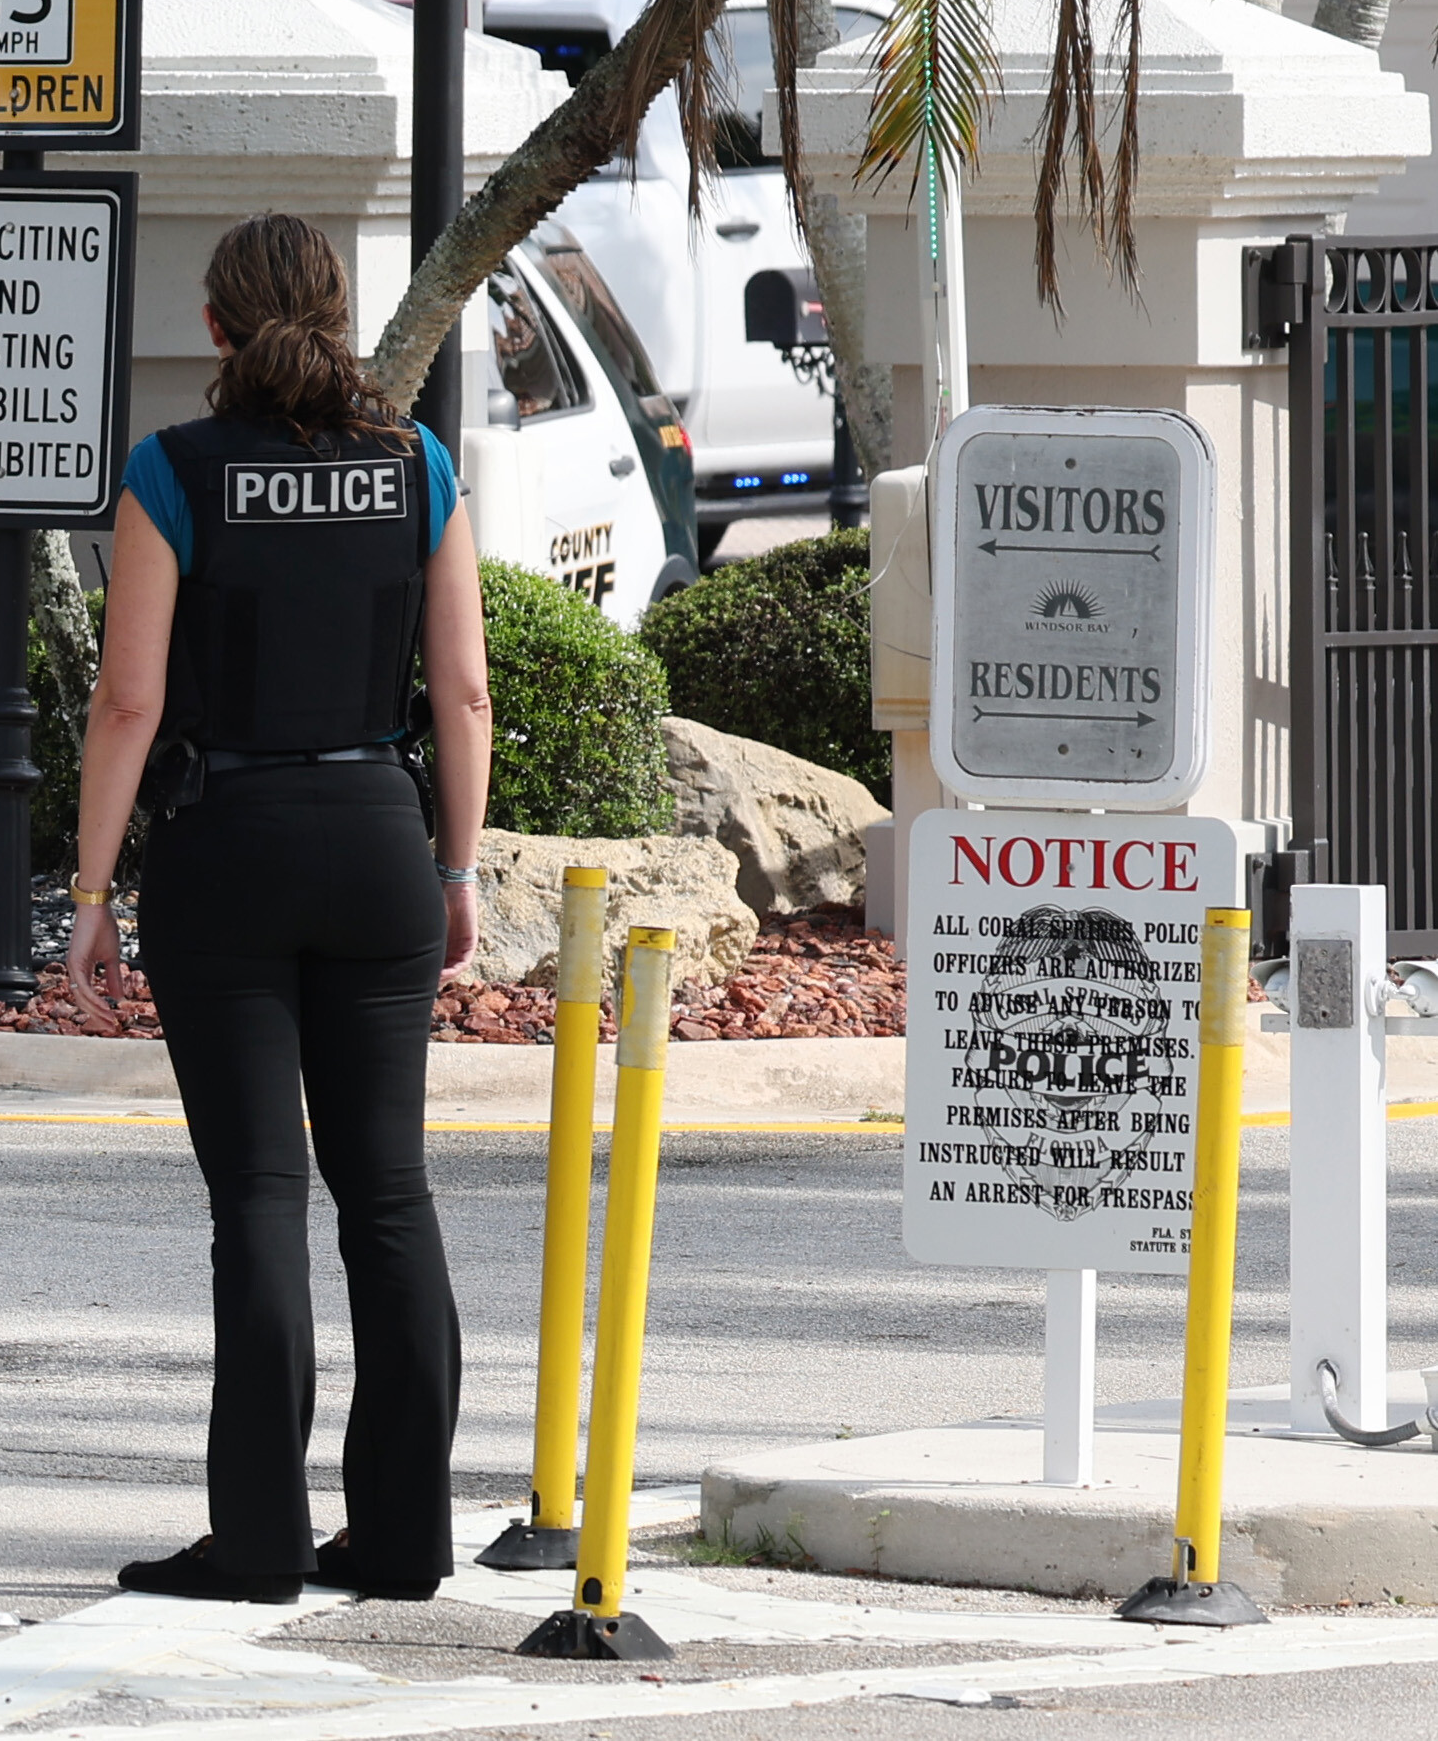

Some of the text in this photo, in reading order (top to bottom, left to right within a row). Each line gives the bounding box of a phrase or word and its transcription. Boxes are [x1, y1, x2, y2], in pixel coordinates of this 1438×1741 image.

[236, 468, 397, 514] POLICE
[974, 483, 1166, 536] VISITORS
[550, 519, 615, 566] COUNTY
[1025, 621, 1111, 634] WINDSOR BAY
[969, 660, 1162, 704] RESIDENTS
[948, 835, 1199, 892] NOTICE
[933, 914, 1200, 945] ALL CORAL SPRINGS POLIC
[933, 952, 1027, 976] OFFICERS
[1037, 956, 1076, 978] ARE
[935, 990, 959, 1011] TO
[968, 991, 1038, 1014] ADVISE
[1048, 995, 1085, 1016] ANY
[1095, 996, 1173, 1020] PERSON
[944, 1028, 1196, 1059] LEAVE THESE PREMISES.
[988, 1041, 1150, 1088] POLICE
[951, 1067, 1187, 1097] FAILURE TO LEAVE THE
[946, 1104, 1190, 1135] PREMISES AFTER BEING
[919, 1141, 1186, 1172] INSTRUCTED WILL RESULT
[1025, 1132, 1110, 1156] FLORIDA
[929, 1180, 956, 1202] AN
[965, 1182, 1044, 1206] ARREST
[1053, 1185, 1091, 1208] FOR
[1129, 1240, 1177, 1254] STATUTE
[1152, 1227, 1192, 1240] FLA. ST
